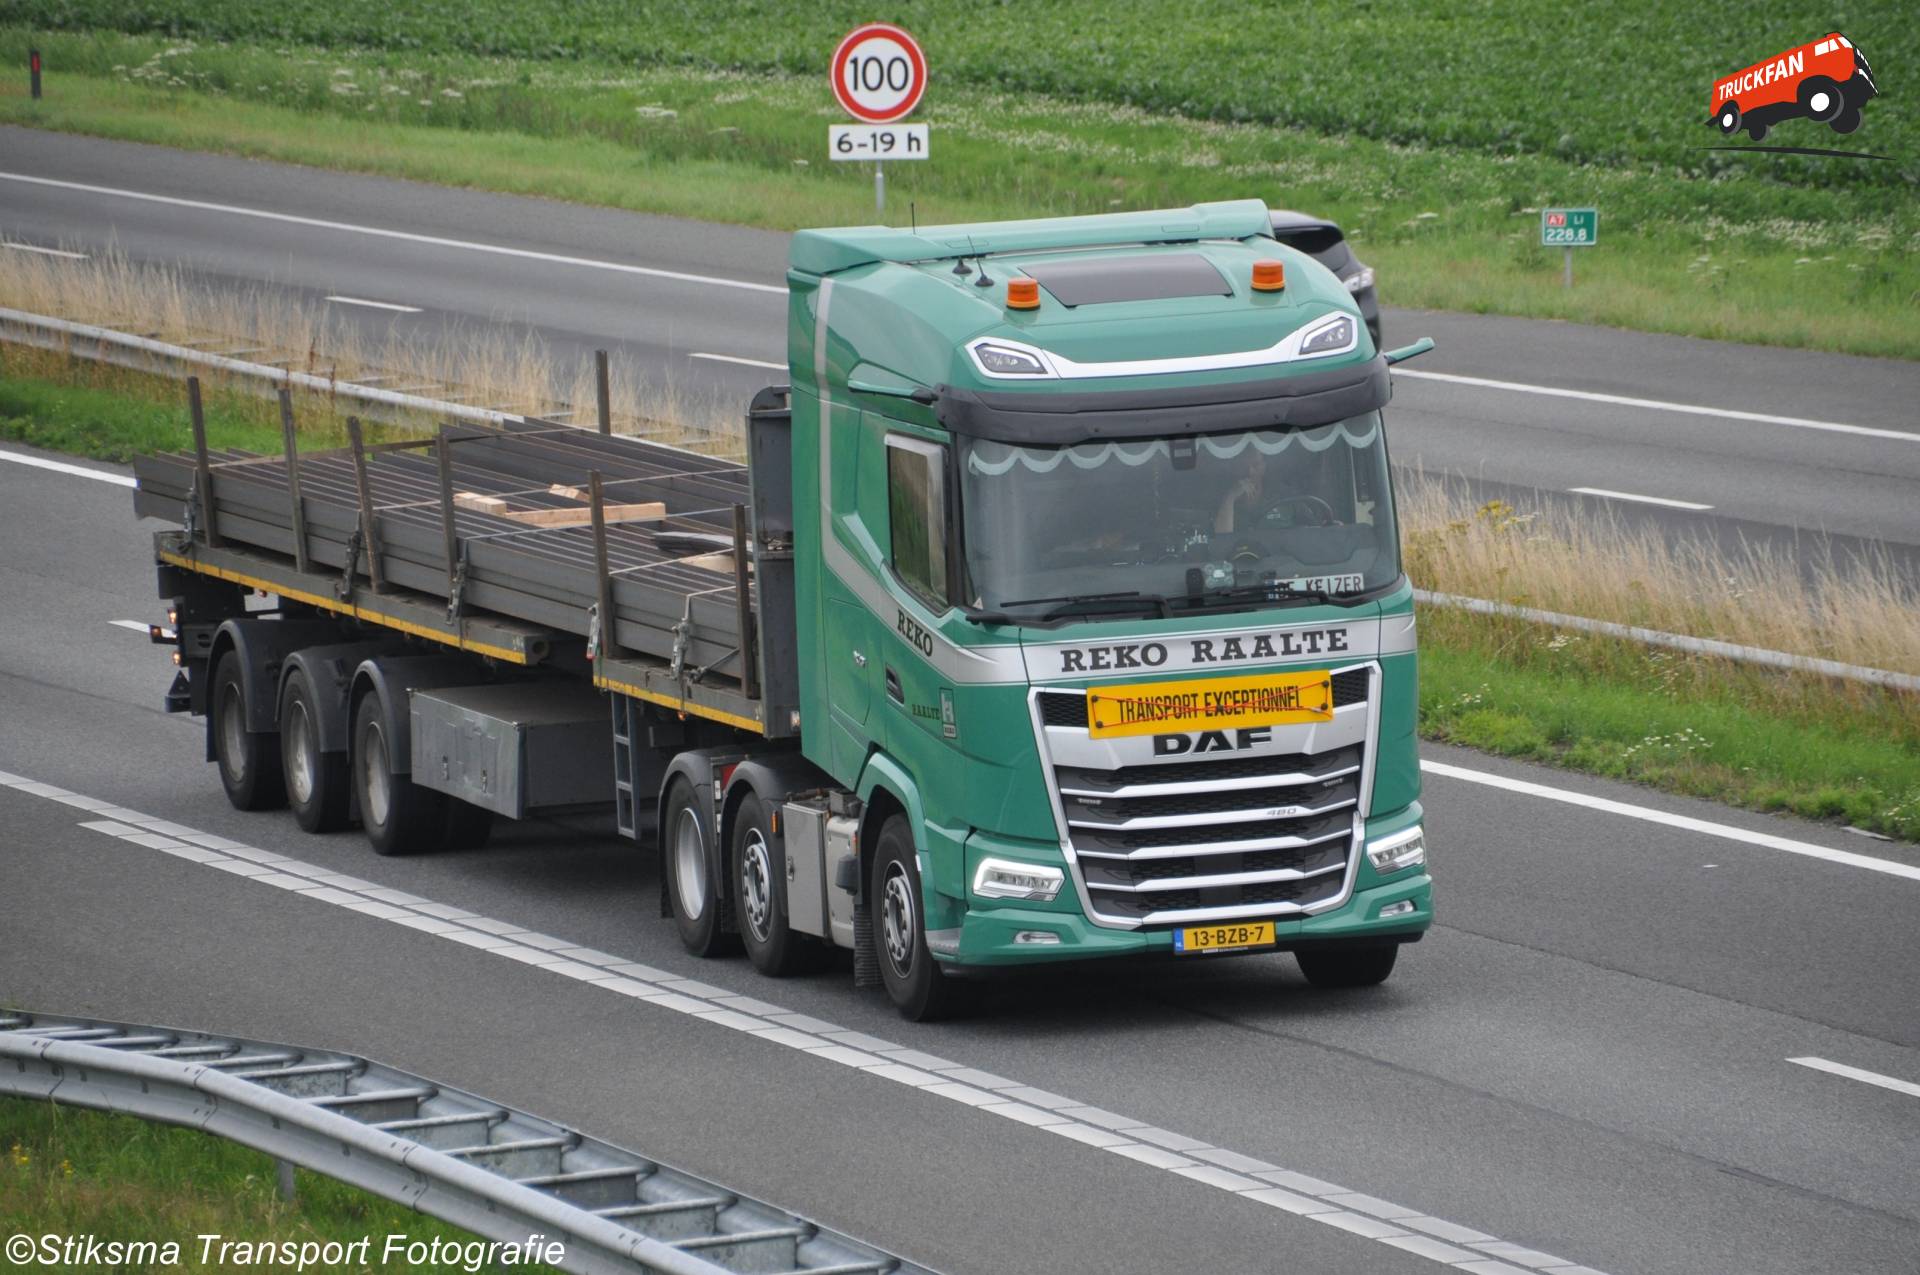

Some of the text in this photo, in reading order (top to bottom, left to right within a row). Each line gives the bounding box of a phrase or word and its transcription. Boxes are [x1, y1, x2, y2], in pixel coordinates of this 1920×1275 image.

[850, 56, 910, 92] 100
[837, 132, 921, 153] 6-19 h
[1548, 214, 1565, 226] A7
[897, 609, 934, 657] REKO
[1061, 628, 1349, 673] REKO RAALTE
[1117, 685, 1304, 723] TRANSPORT EXCEPTIONNEL
[1153, 725, 1272, 757] DAF
[1193, 925, 1265, 947] 13-BZB-7
